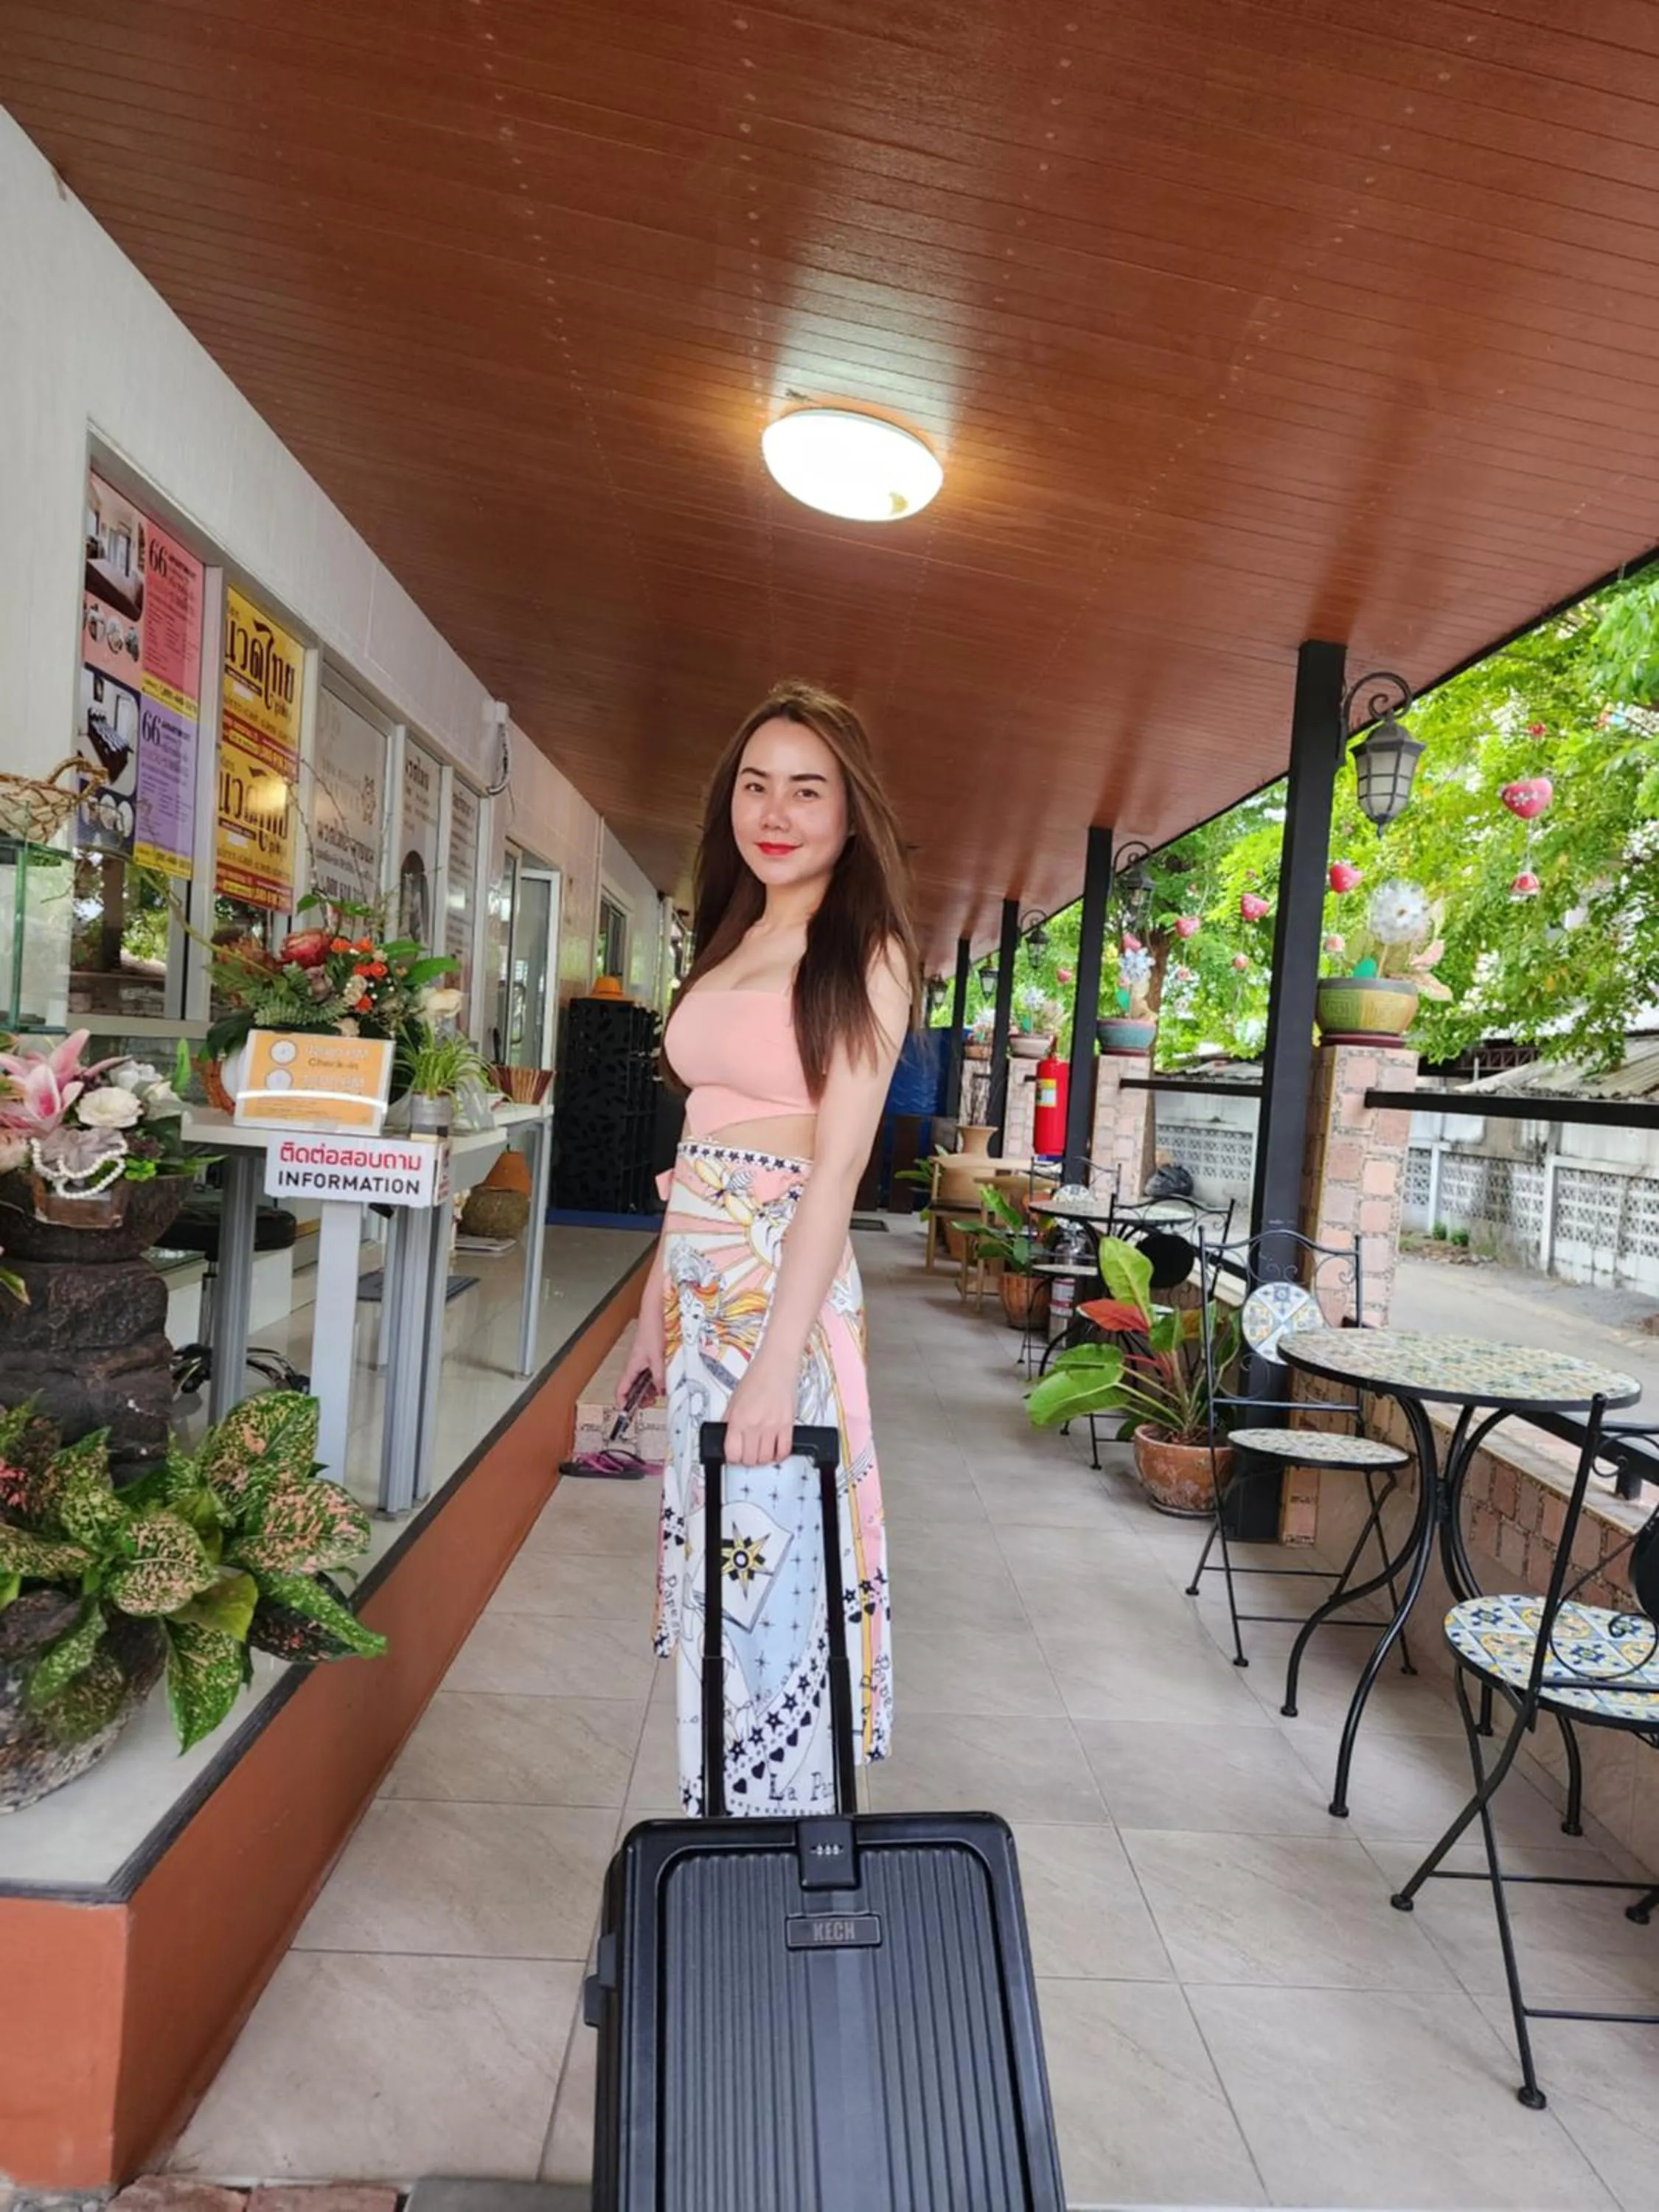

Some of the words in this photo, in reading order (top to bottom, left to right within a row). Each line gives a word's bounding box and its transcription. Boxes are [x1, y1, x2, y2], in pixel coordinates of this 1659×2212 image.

[149, 538, 167, 578] 66
[142, 710, 161, 747] 66
[279, 1141, 422, 1171] ติดต่อสอบถาม
[278, 1171, 420, 1194] INFORMATION
[768, 1773, 798, 1801] La
